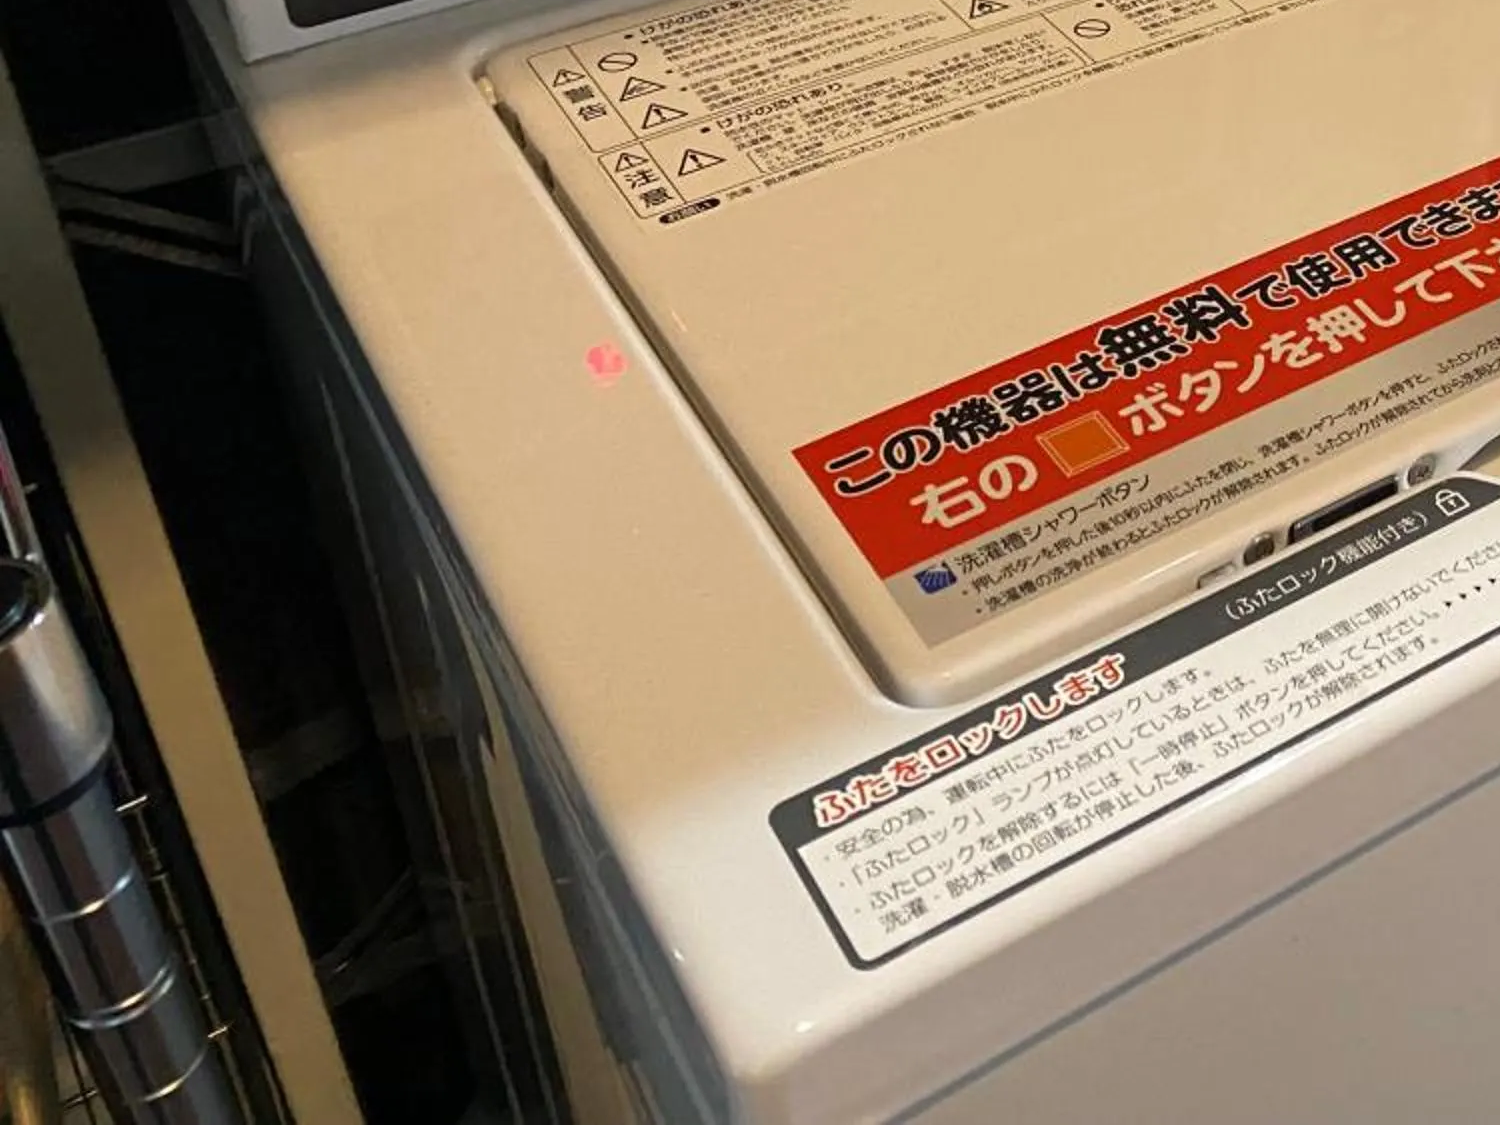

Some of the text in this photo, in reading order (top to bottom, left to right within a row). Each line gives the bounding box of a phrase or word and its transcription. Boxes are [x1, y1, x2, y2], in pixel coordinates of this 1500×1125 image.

[622, 166, 674, 209] 注意
[910, 453, 1039, 530] 右の
[955, 475, 1150, 574] 洗濯槽シャワーボタン
[814, 654, 1125, 828] ふたをロックします
